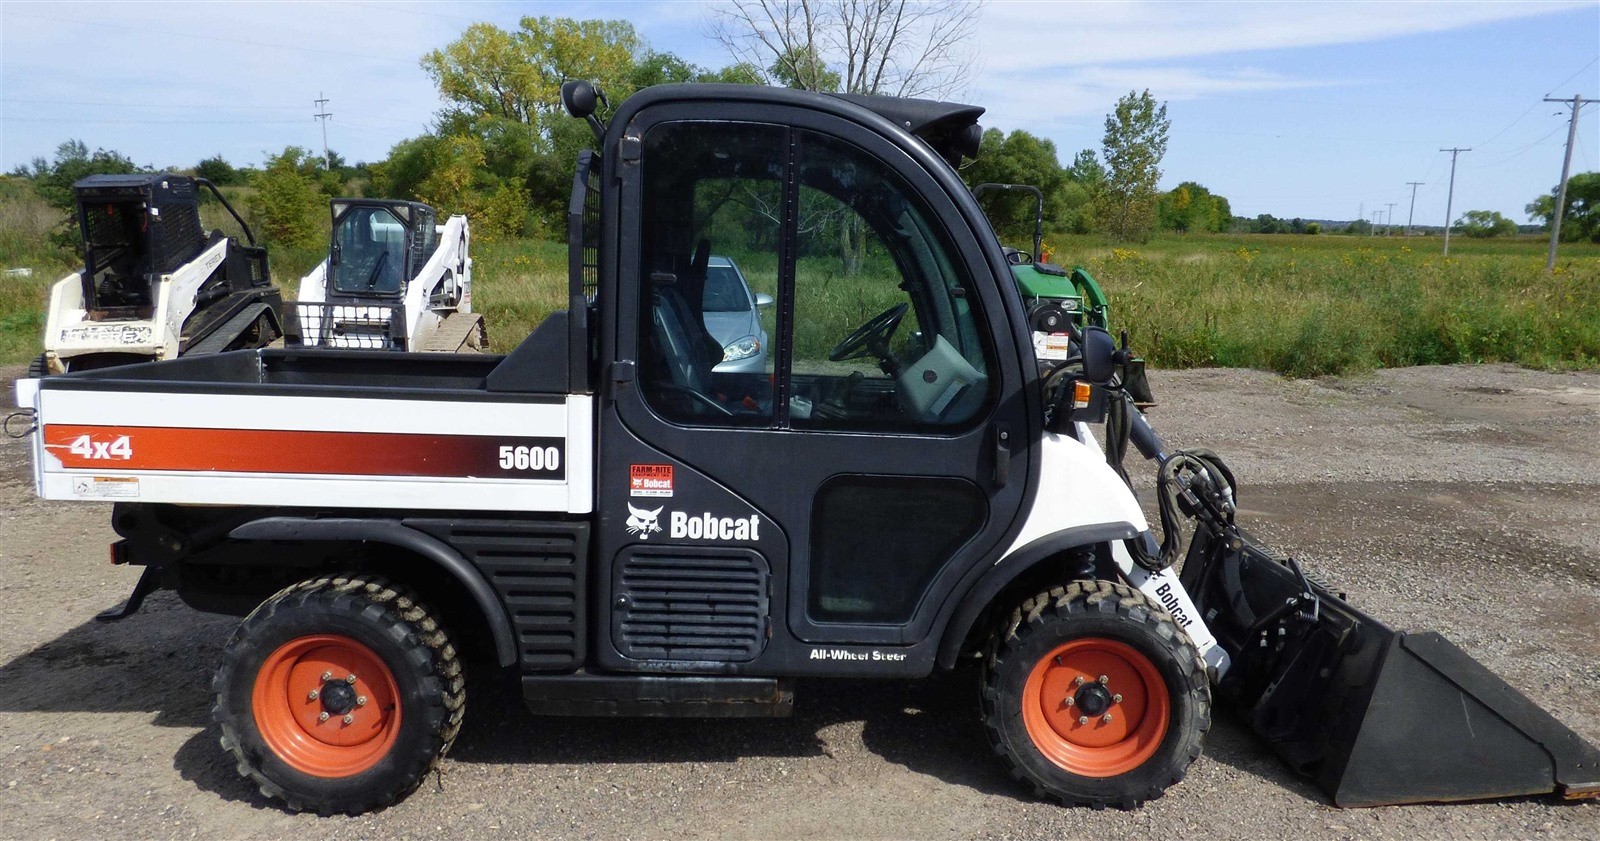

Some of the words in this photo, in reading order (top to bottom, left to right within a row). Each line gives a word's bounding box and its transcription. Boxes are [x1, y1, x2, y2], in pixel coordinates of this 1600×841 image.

[71, 434, 133, 460] 4x4
[499, 445, 559, 471] 5600
[632, 466, 671, 474] FARM-RITE
[643, 478, 671, 488] Bobcat
[670, 511, 760, 541] Bobcat
[1155, 582, 1193, 628] Bobcat
[810, 649, 869, 661] All-Wheel
[872, 650, 907, 661] Steer
